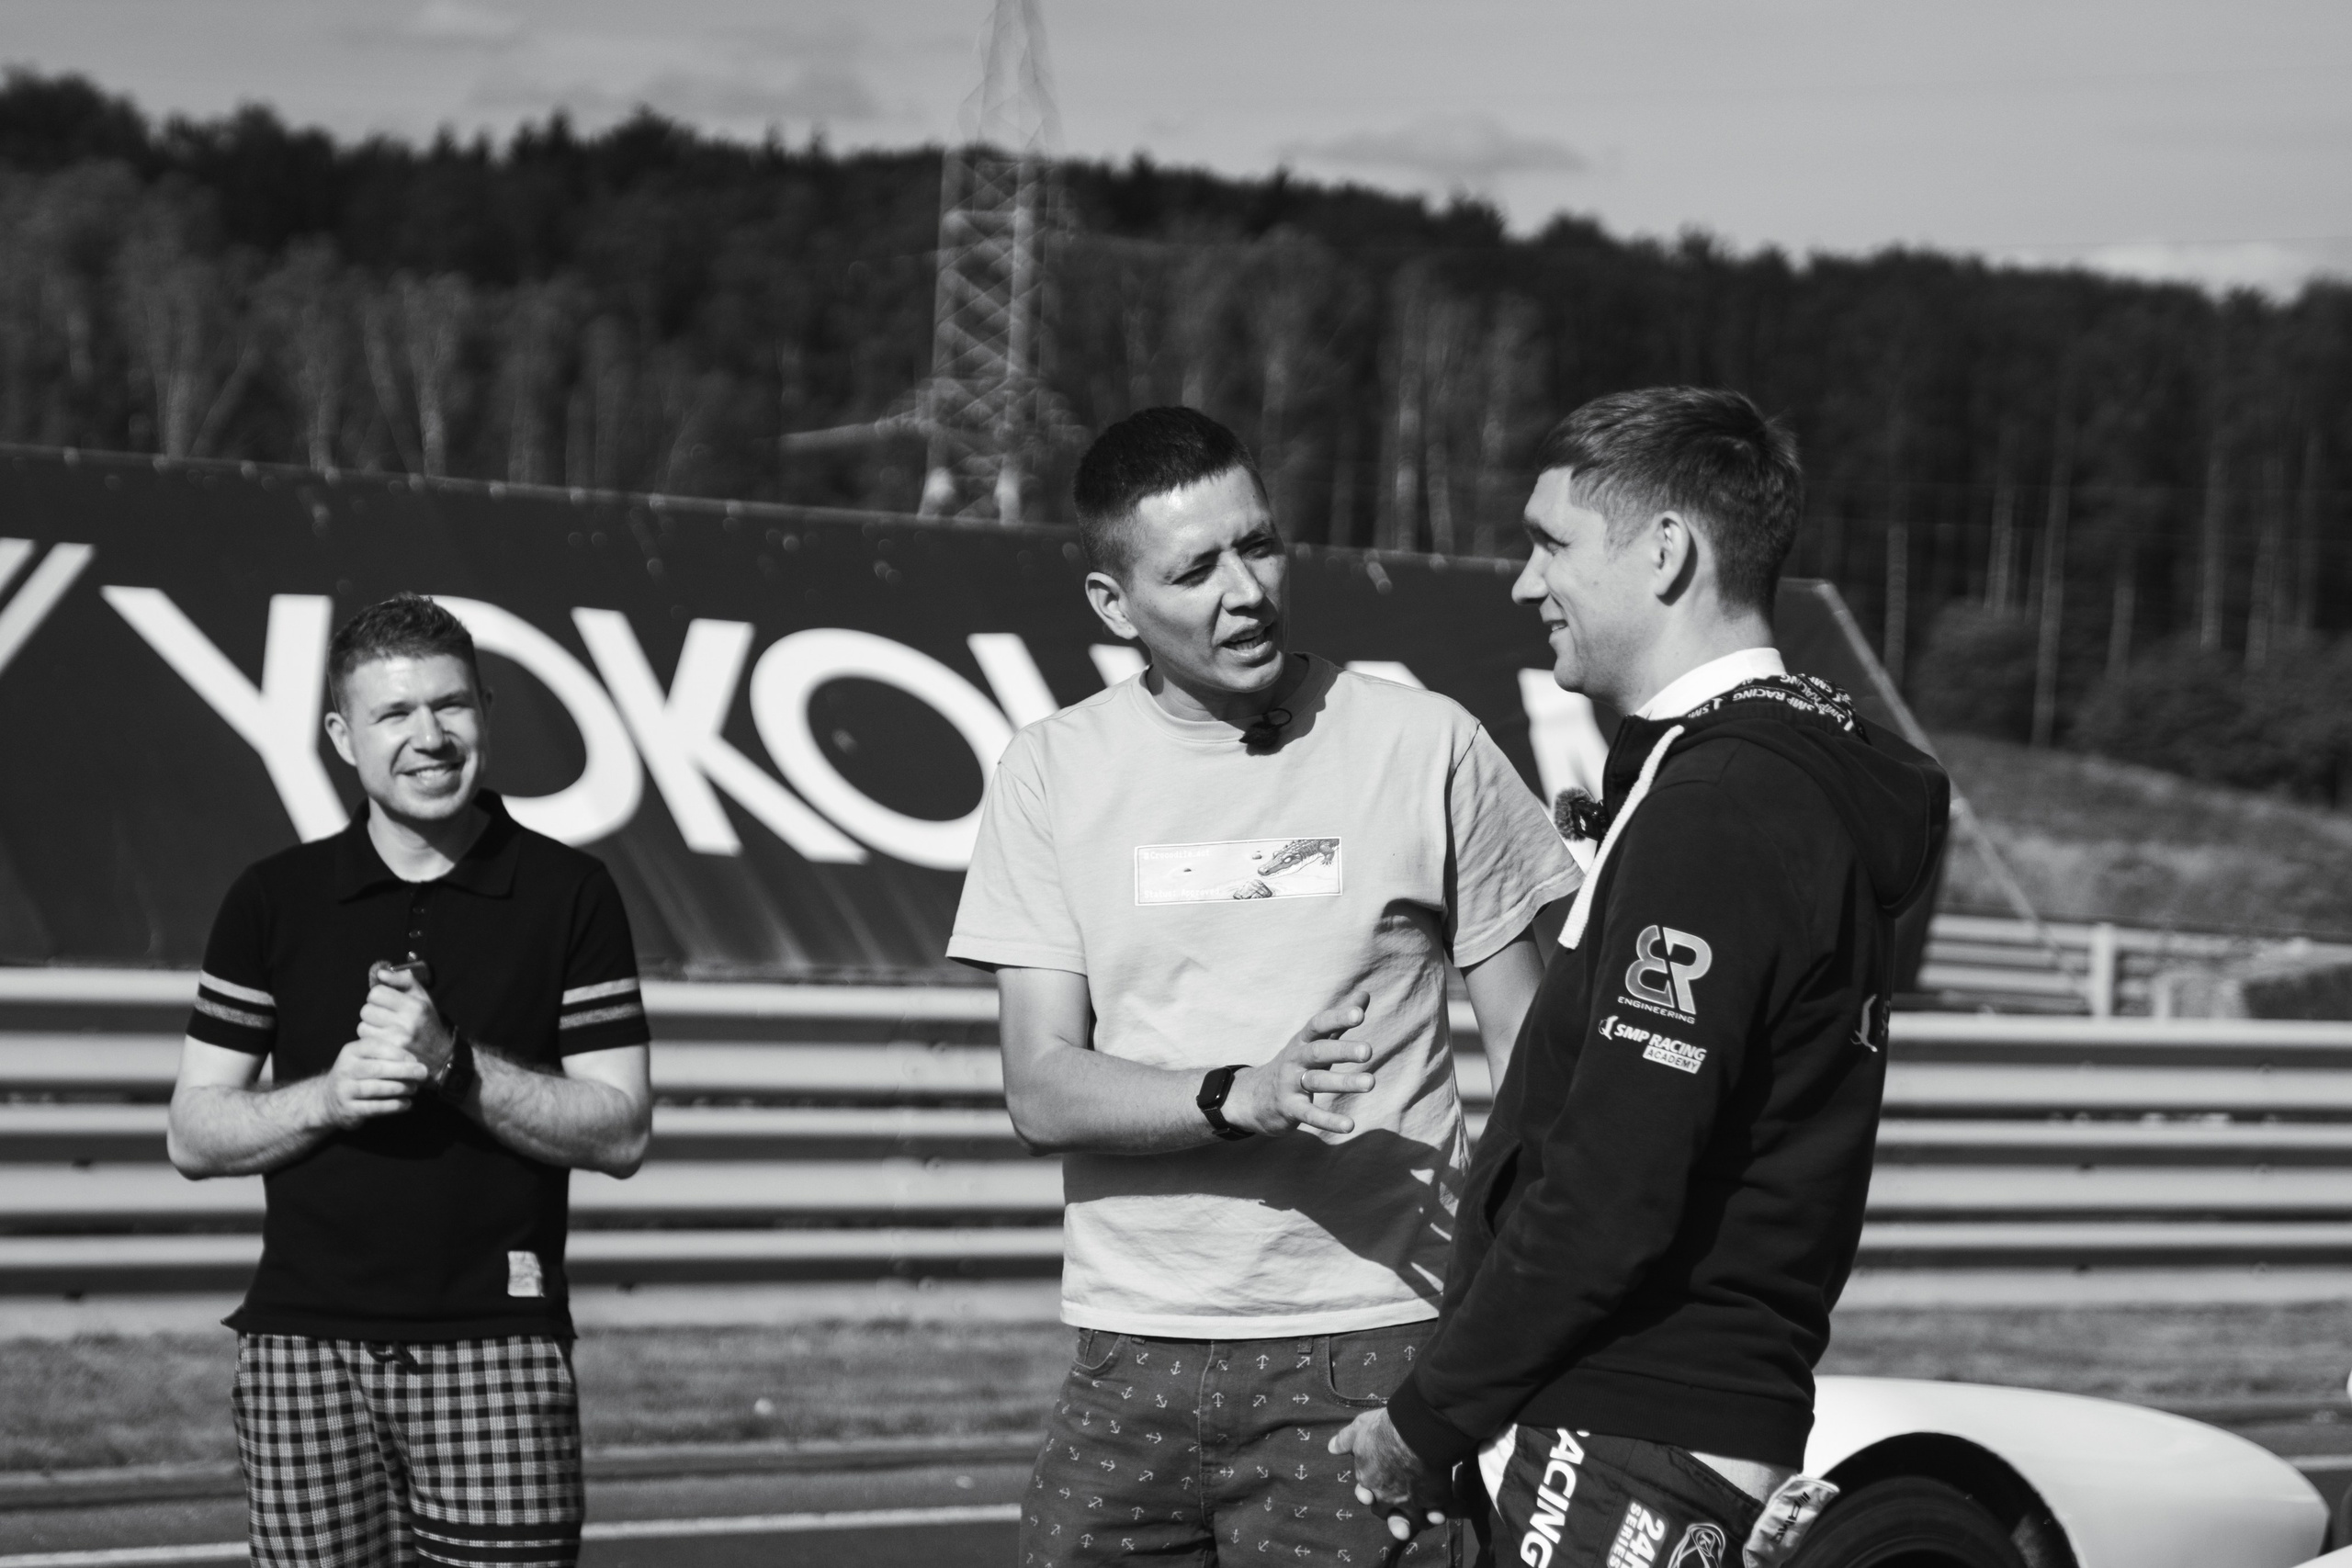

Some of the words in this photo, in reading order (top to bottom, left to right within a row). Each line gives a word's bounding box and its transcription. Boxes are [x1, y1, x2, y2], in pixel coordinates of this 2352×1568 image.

[1732, 687, 1786, 702] RACING
[1181, 886, 1220, 898] Approved
[1617, 996, 1696, 1025] ENGINEERING
[1614, 1023, 1650, 1043] SMP
[1648, 1033, 1707, 1062] RACING
[1646, 1048, 1701, 1072] ACADEMY
[1520, 1427, 1589, 1568] ACING
[1608, 1502, 1642, 1568] SERIES
